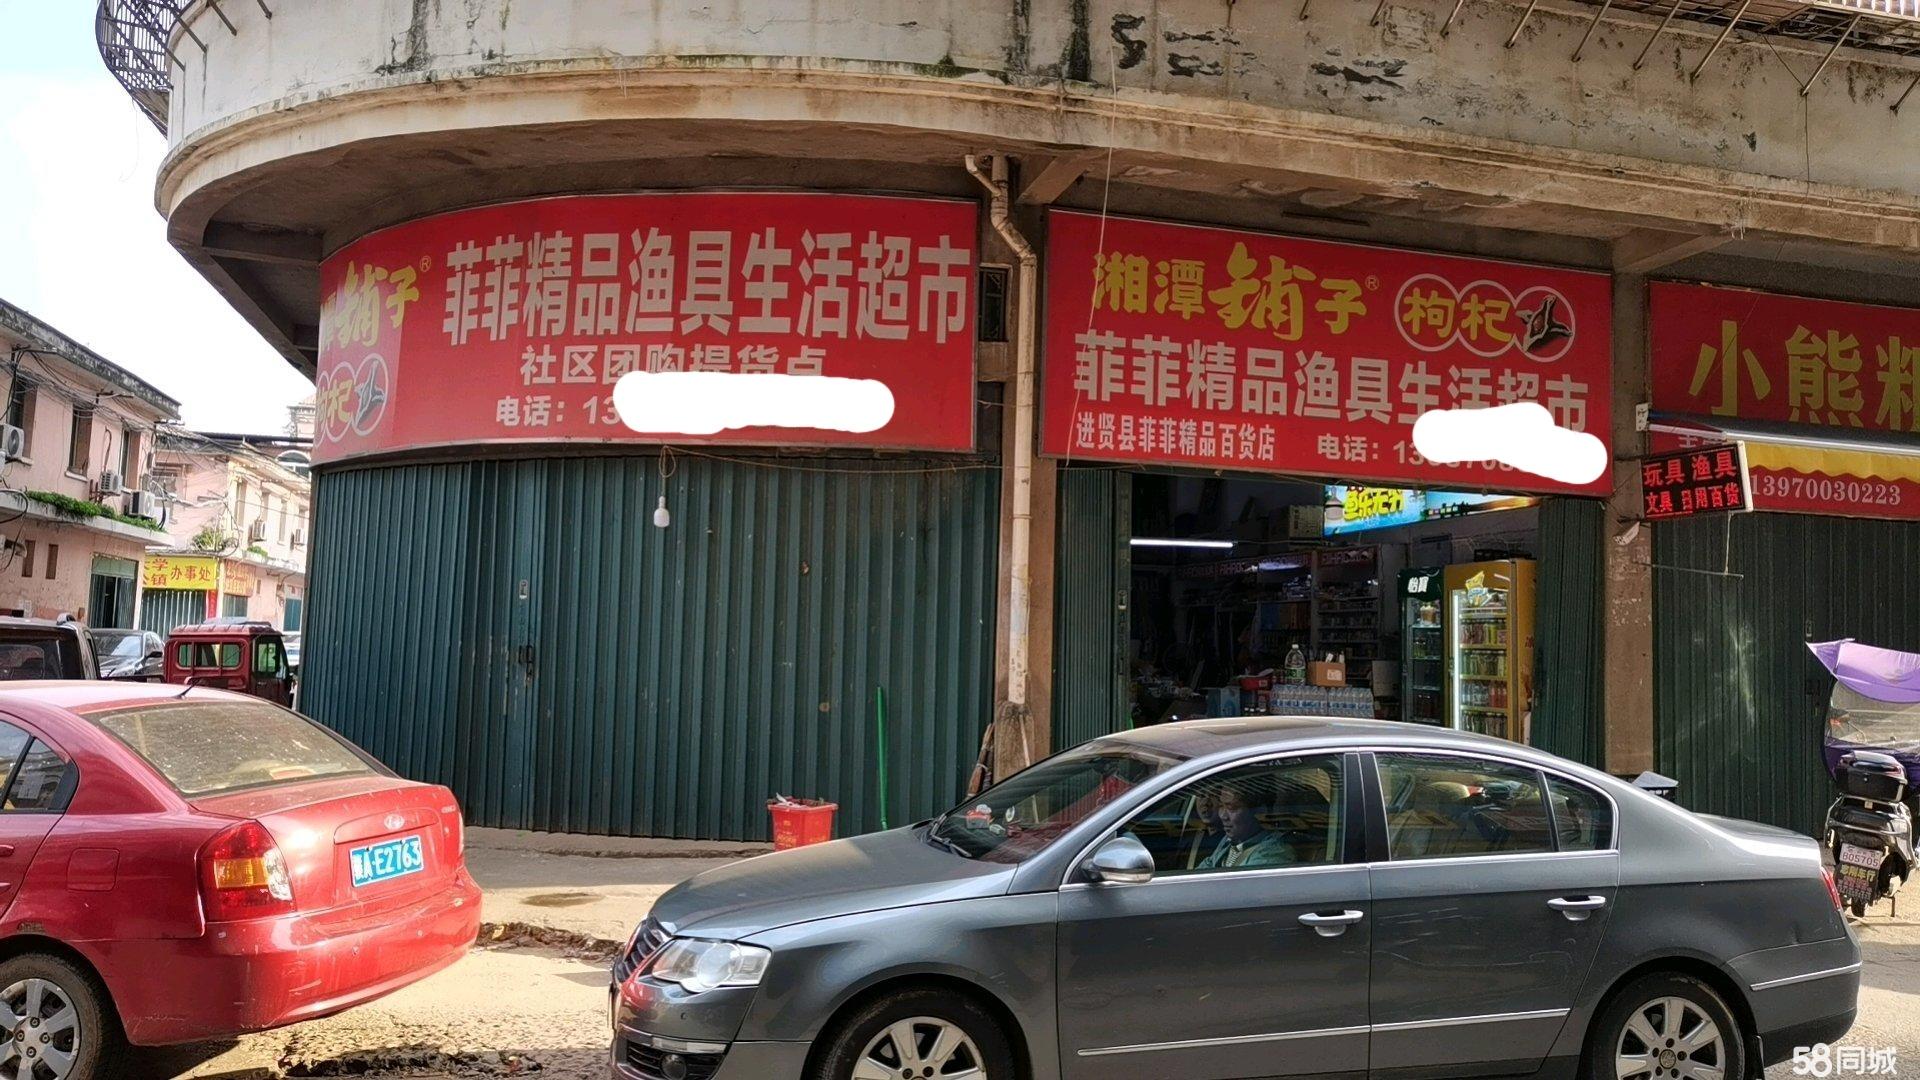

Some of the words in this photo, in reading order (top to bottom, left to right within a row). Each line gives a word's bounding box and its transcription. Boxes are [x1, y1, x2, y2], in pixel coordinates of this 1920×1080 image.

[443, 227, 972, 345] 菲菲精品渔具生活超市
[1092, 242, 1368, 341] 湘潭铺子
[1403, 287, 1512, 342] 枸杞
[520, 343, 827, 386] 社区团购提货点
[1073, 329, 1589, 434] 菲菲精品渔具生活超市
[1076, 411, 1276, 461] 进贤县菲菲精品百货店
[1643, 459, 1685, 487] 玩具
[1692, 450, 1737, 481] 渔具
[1751, 475, 1901, 506] 13970030223
[1645, 491, 1673, 513] 文具
